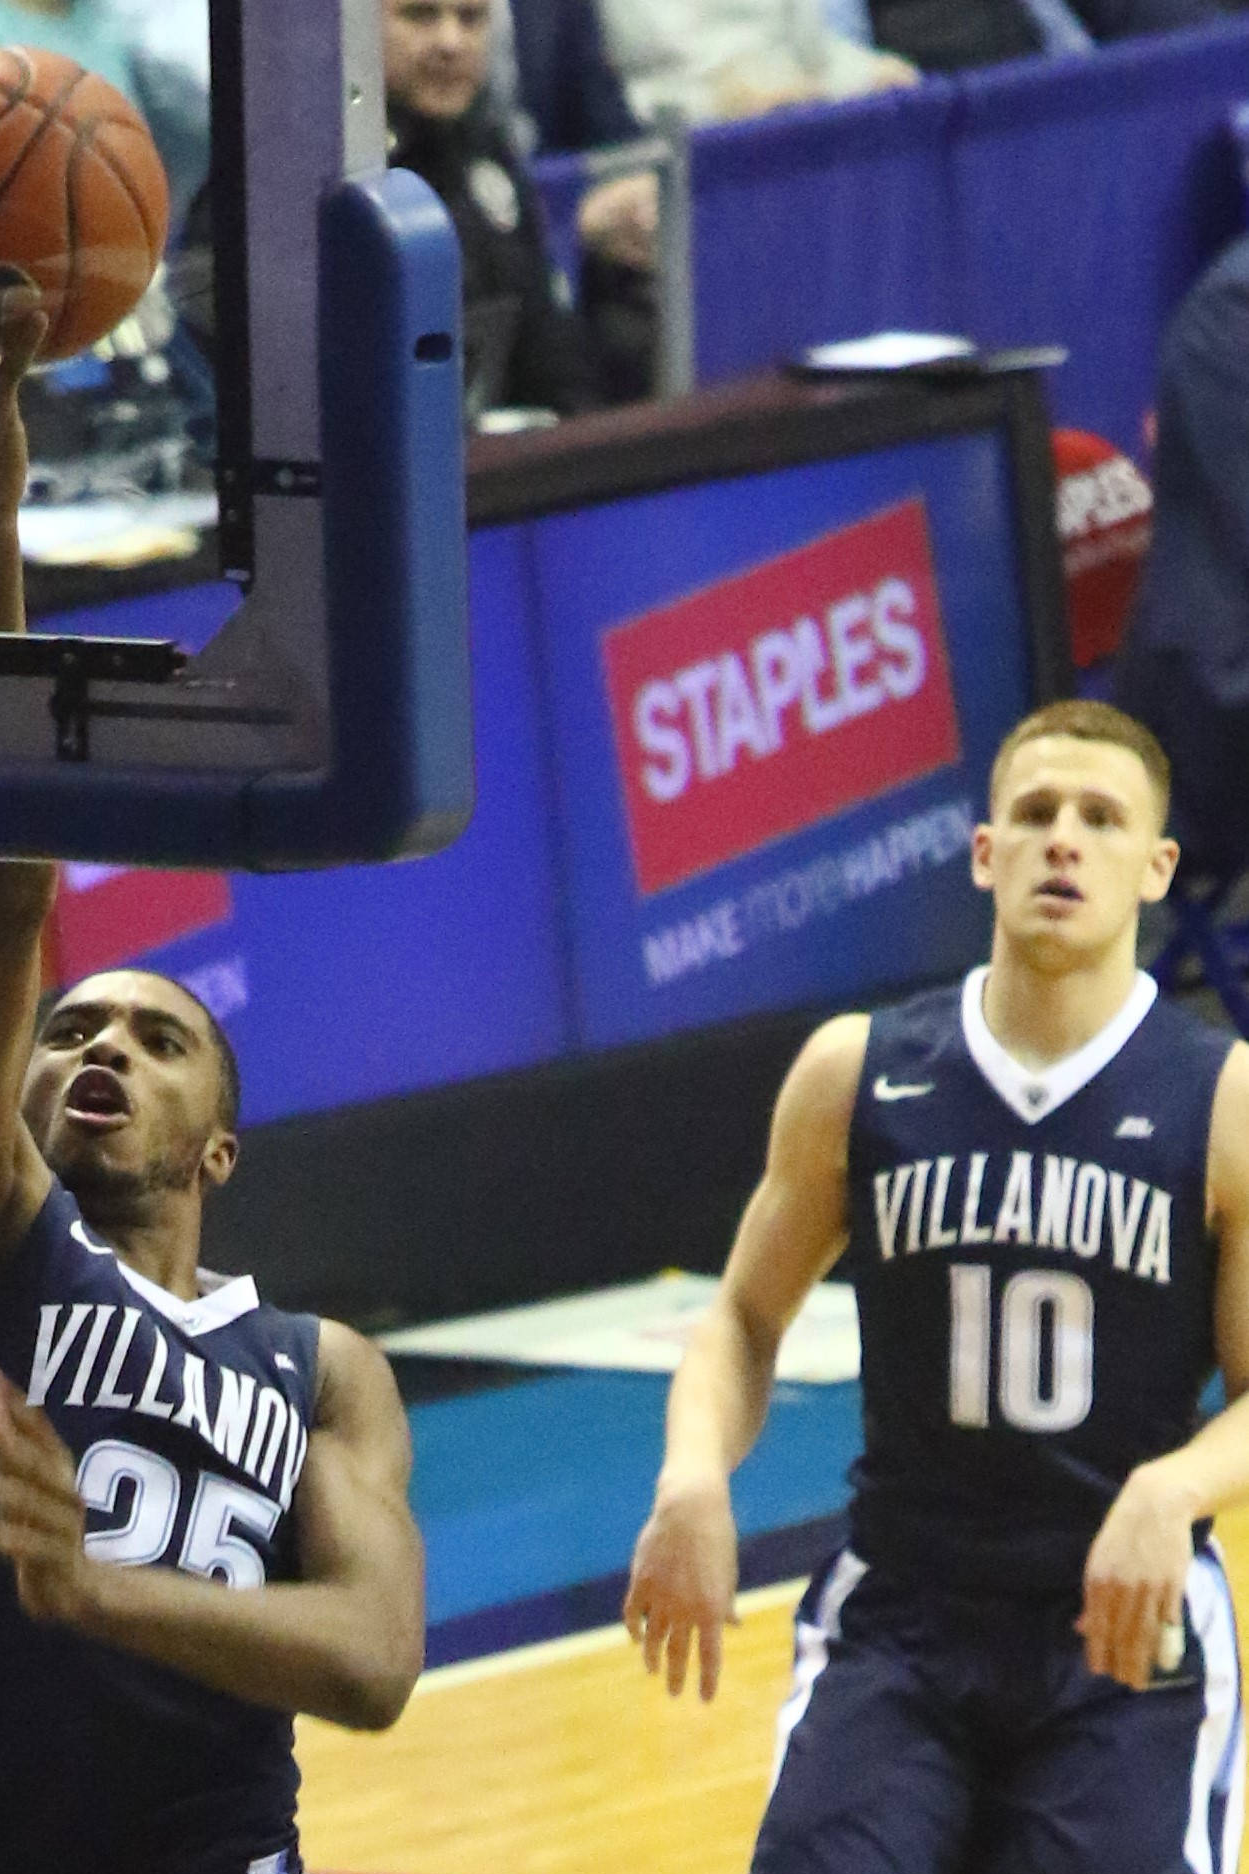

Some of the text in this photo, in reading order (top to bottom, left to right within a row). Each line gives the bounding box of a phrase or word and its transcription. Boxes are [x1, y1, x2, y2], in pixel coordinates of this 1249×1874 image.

[634, 576, 927, 802] STAPLES
[642, 900, 745, 985] MAKE
[873, 1150, 1172, 1284] VILLANOVA
[26, 1303, 308, 1513] VILLANOV
[949, 1263, 1094, 1433] 10
[76, 1439, 282, 1592] 25
